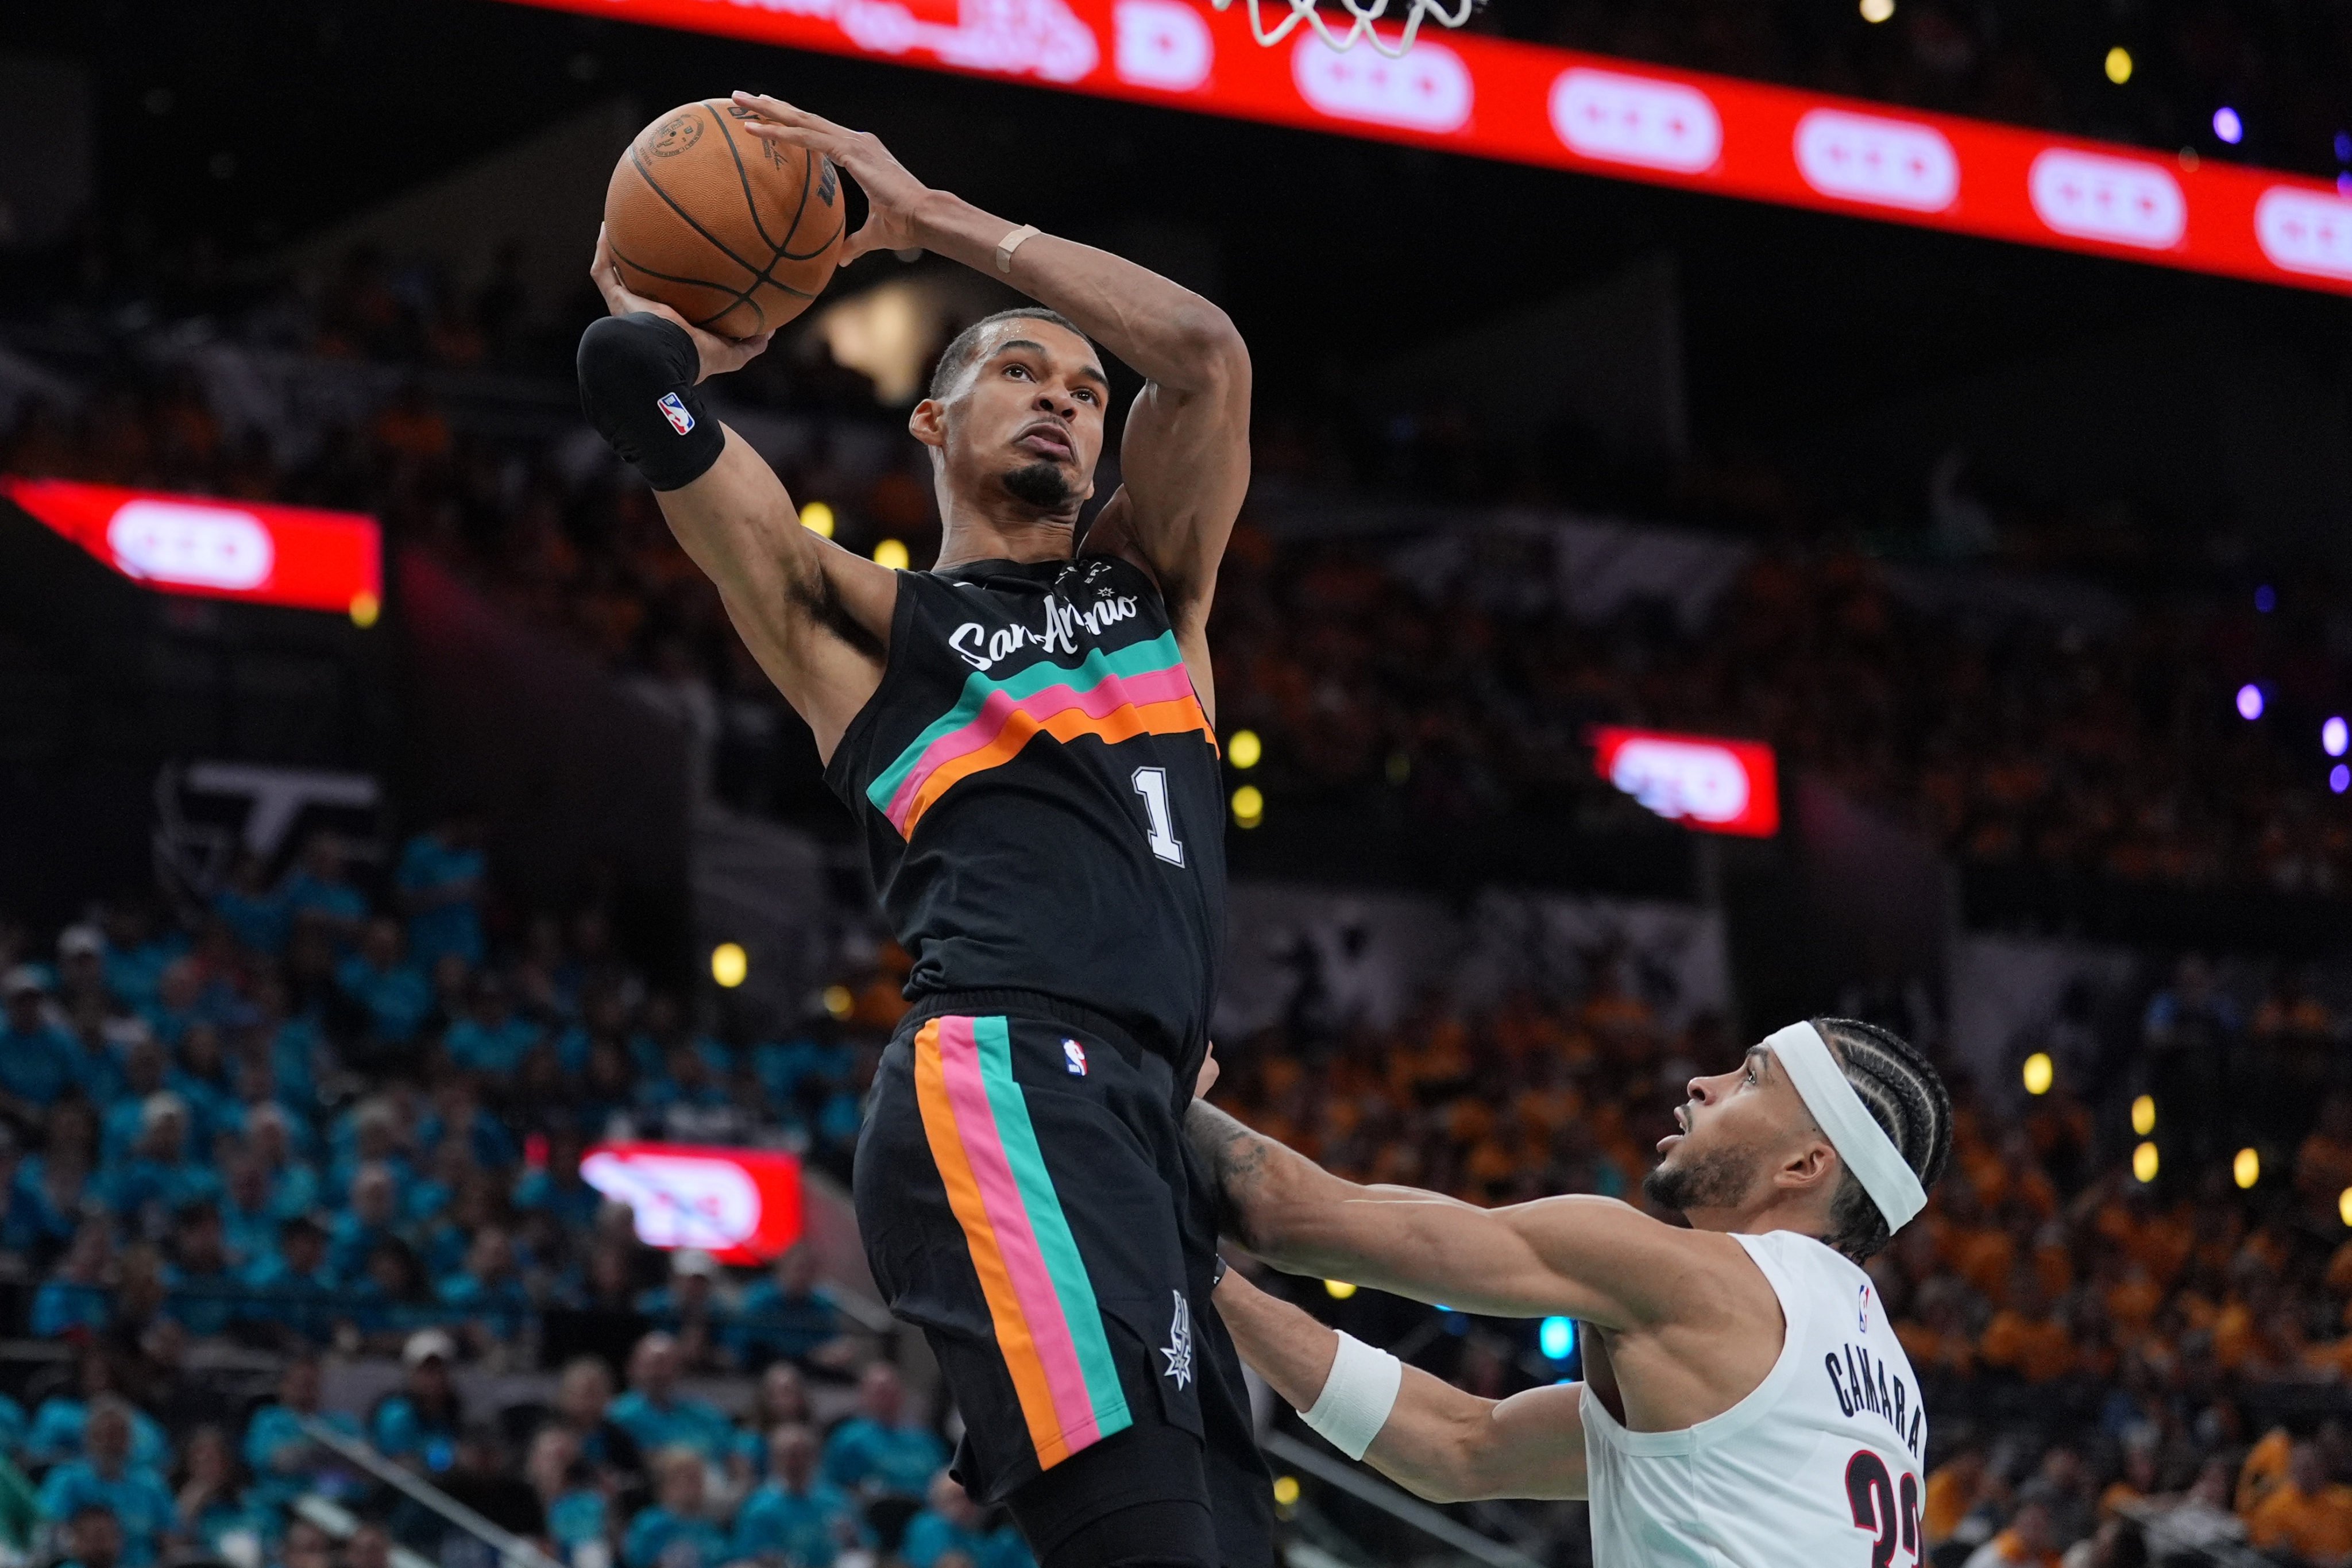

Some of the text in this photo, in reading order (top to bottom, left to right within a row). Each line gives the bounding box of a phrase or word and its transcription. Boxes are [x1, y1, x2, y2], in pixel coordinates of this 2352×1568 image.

[948, 592, 1138, 671] San Annio
[1131, 766, 1185, 868] 1
[1825, 1343, 1922, 1458] CAMARA
